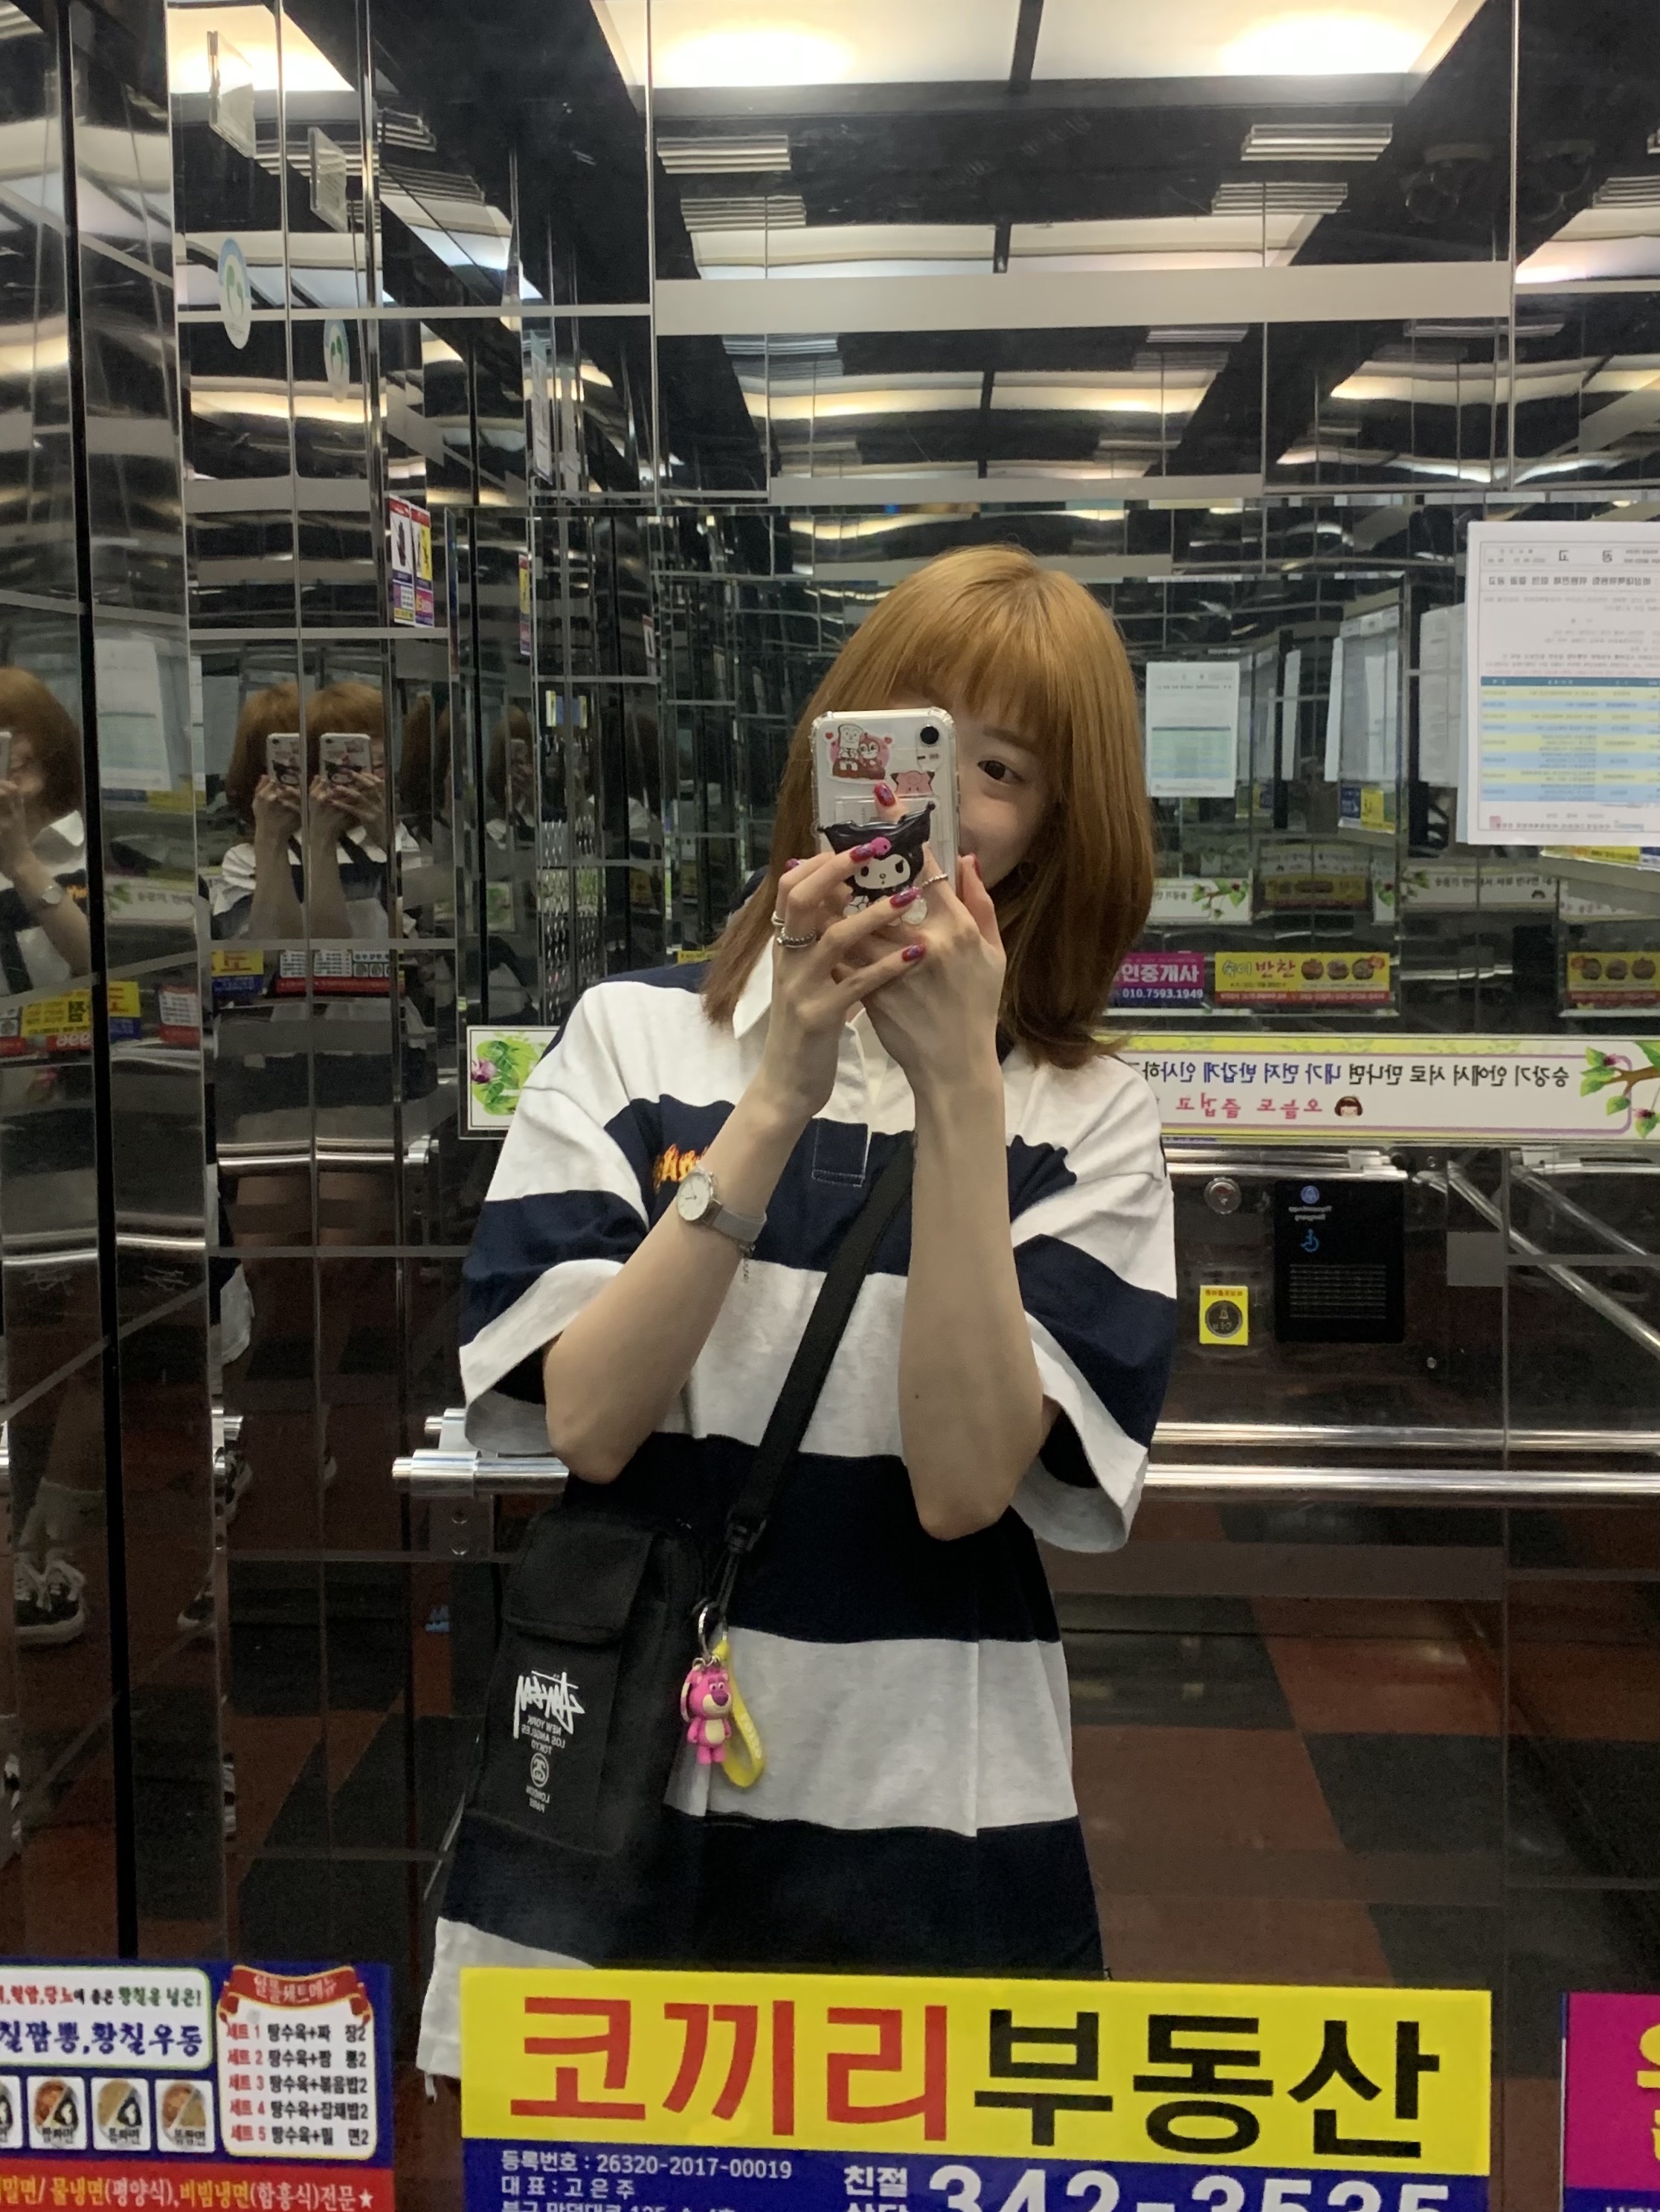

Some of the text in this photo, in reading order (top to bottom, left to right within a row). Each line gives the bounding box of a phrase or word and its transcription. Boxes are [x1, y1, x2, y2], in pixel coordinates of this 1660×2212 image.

[1113, 964, 1200, 982] 인중개사
[227, 2023, 250, 2040] 세트
[254, 2024, 260, 2040] 1
[228, 2048, 251, 2066] 세트
[255, 2050, 263, 2065] 2
[229, 2074, 251, 2091] 세트
[256, 2075, 264, 2091] 3
[511, 1996, 1441, 2158] 코끼리부동산
[231, 2098, 252, 2116] 세트
[257, 2100, 265, 2115] 4
[231, 2124, 254, 2141] 세트
[258, 2126, 266, 2141] 5
[596, 2154, 793, 2179] 26320-2017-00019
[843, 2164, 907, 2197] 친절
[0, 2175, 46, 2205] 밀면/
